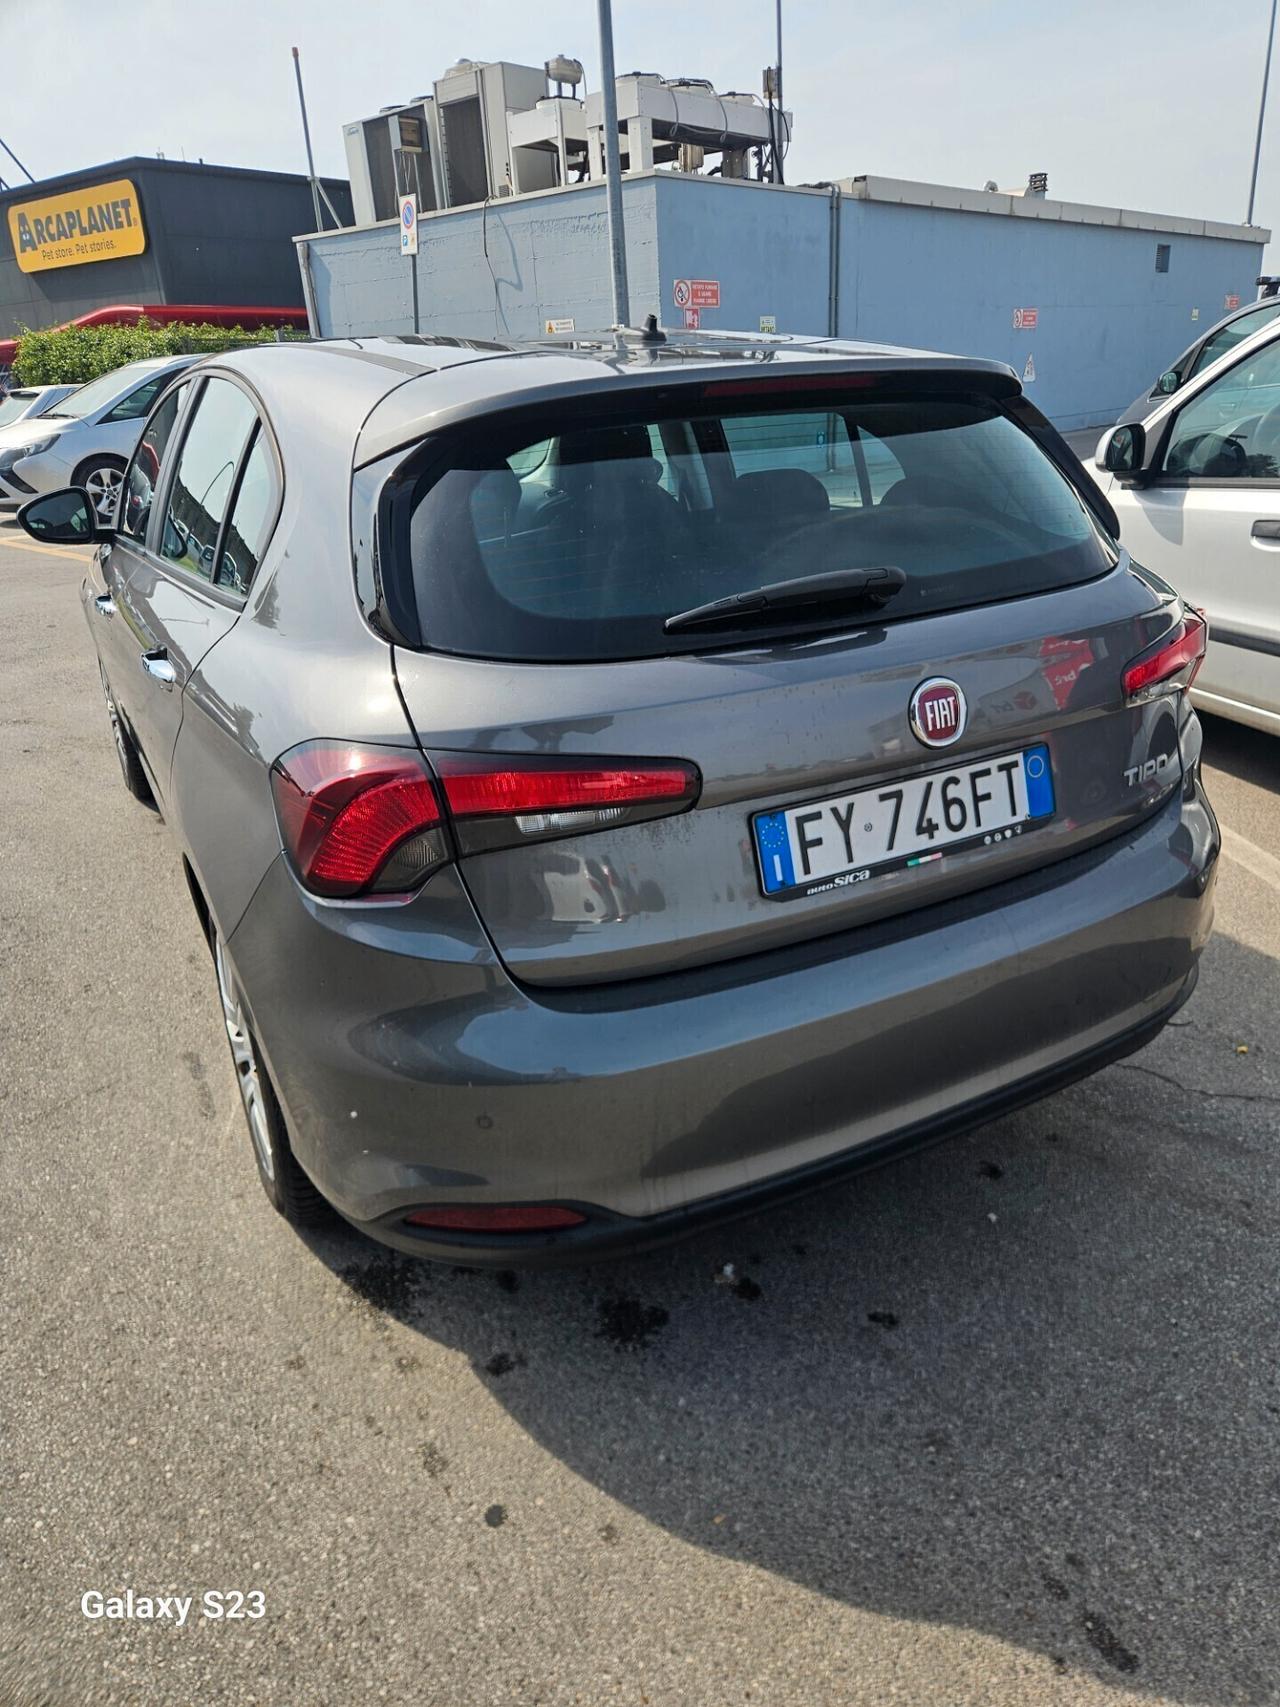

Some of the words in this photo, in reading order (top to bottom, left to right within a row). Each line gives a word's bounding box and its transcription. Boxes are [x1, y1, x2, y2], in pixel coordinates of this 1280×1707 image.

[42, 249, 54, 261] Pet
[76, 243, 89, 255] Pet
[925, 695, 956, 732] FIAT
[1123, 753, 1168, 787] TIPO
[795, 802, 855, 876] FY
[878, 760, 1020, 851] 746FT
